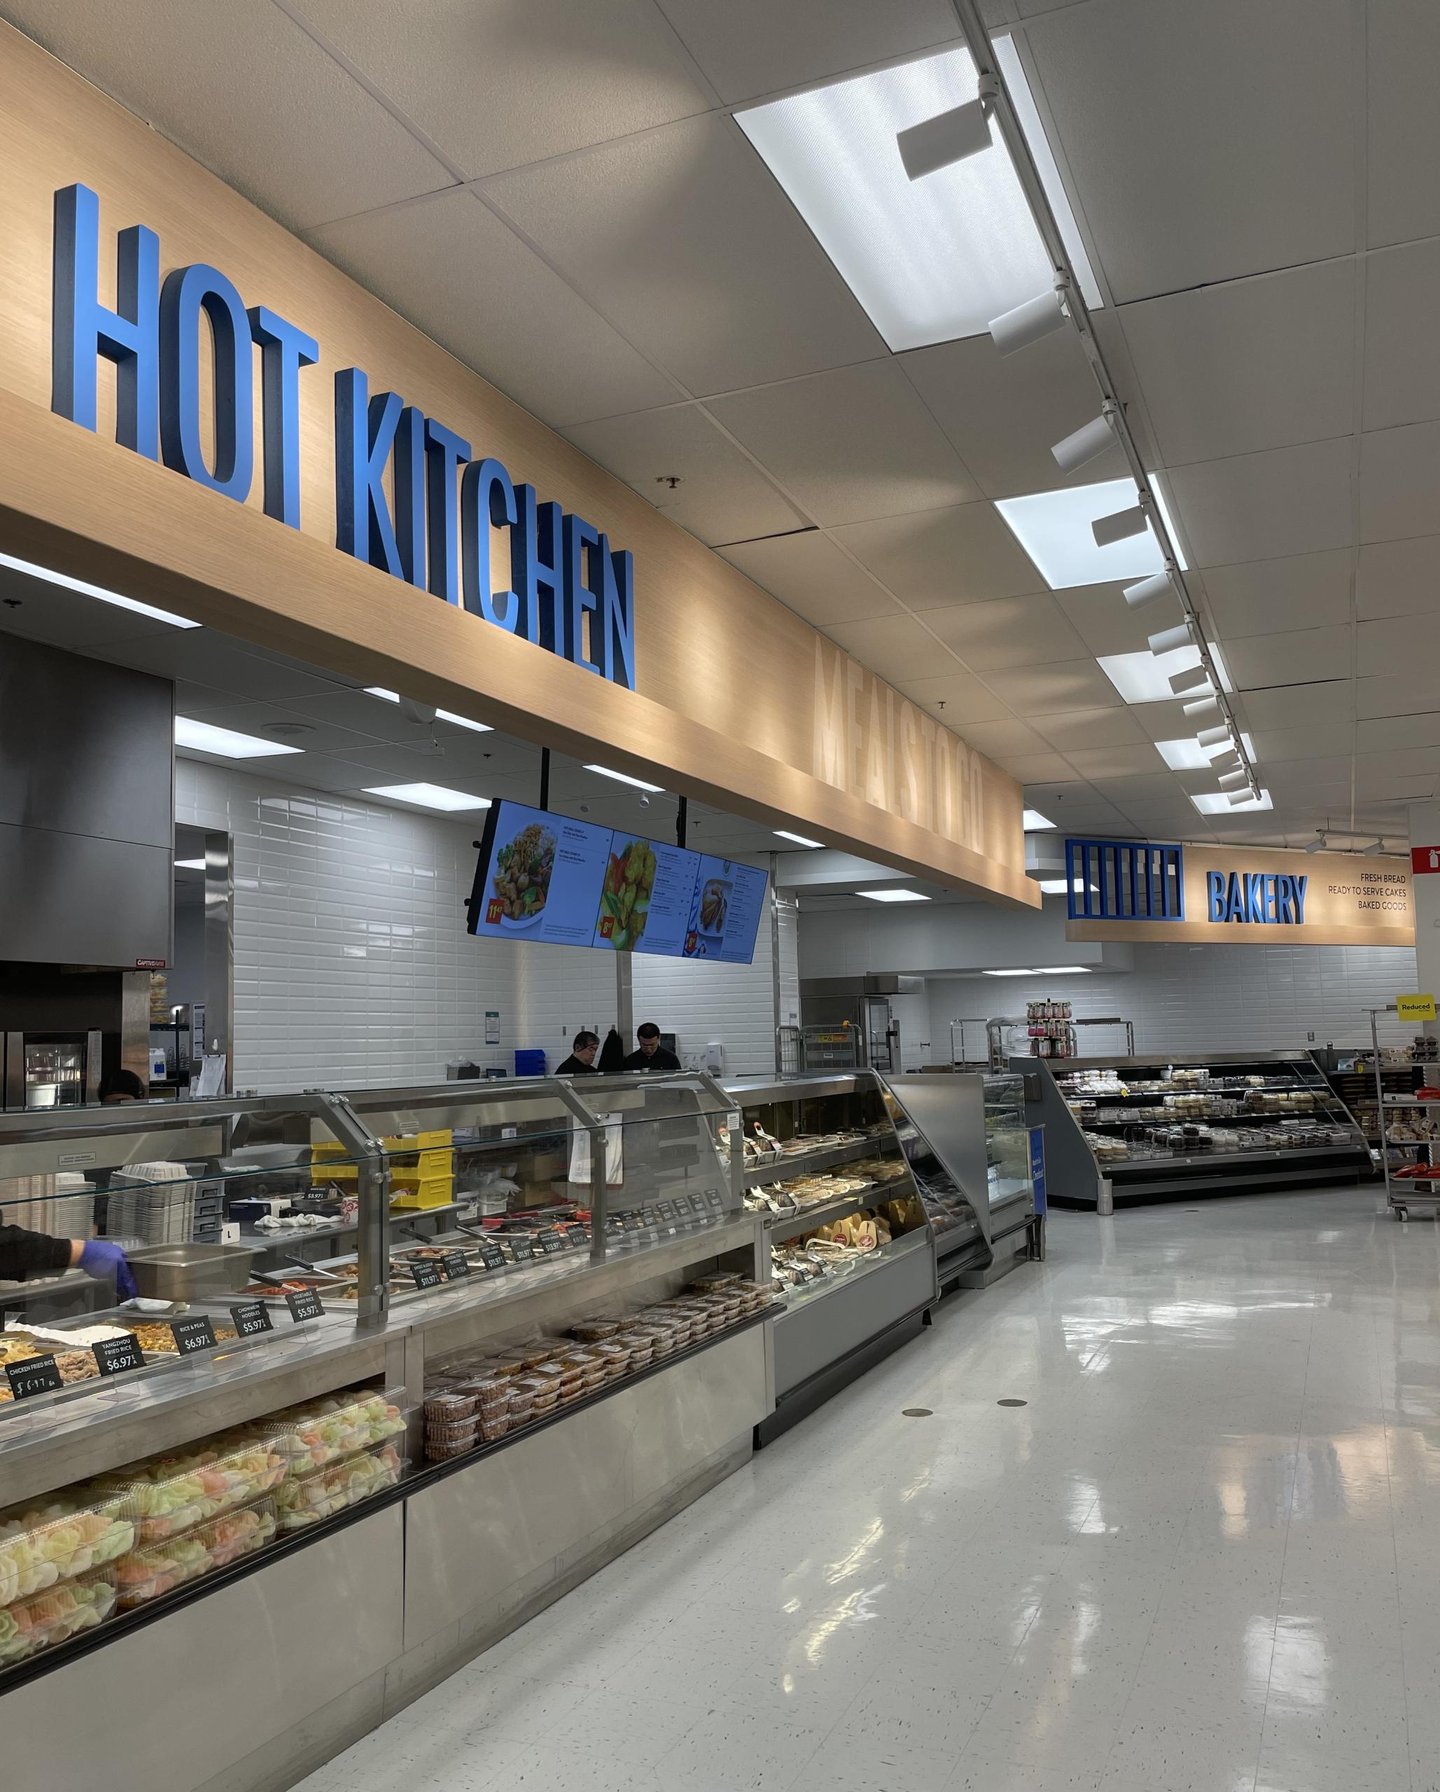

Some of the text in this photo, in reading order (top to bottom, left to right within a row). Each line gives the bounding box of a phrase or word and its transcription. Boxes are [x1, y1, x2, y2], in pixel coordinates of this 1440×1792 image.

[52, 183, 636, 692] HOT KITCHEN
[1360, 873, 1406, 884] FRESH BREAD
[1206, 870, 1308, 924] BAKERY
[1328, 885, 1407, 897] READY TO SERVE CAKES
[1358, 900, 1407, 911] BAKED GOODS
[1401, 1002, 1431, 1010] Reduced
[297, 1306, 315, 1319] $5.97
[194, 1321, 205, 1330] PEAS
[243, 1319, 263, 1333] $5.97
[101, 1338, 131, 1349] YANGZHOU
[184, 1334, 206, 1350] $6.97
[104, 1344, 132, 1356] FRIED RICE
[9, 1359, 55, 1376] CHICKEN FRIED RICE
[106, 1355, 131, 1372] $6.97
